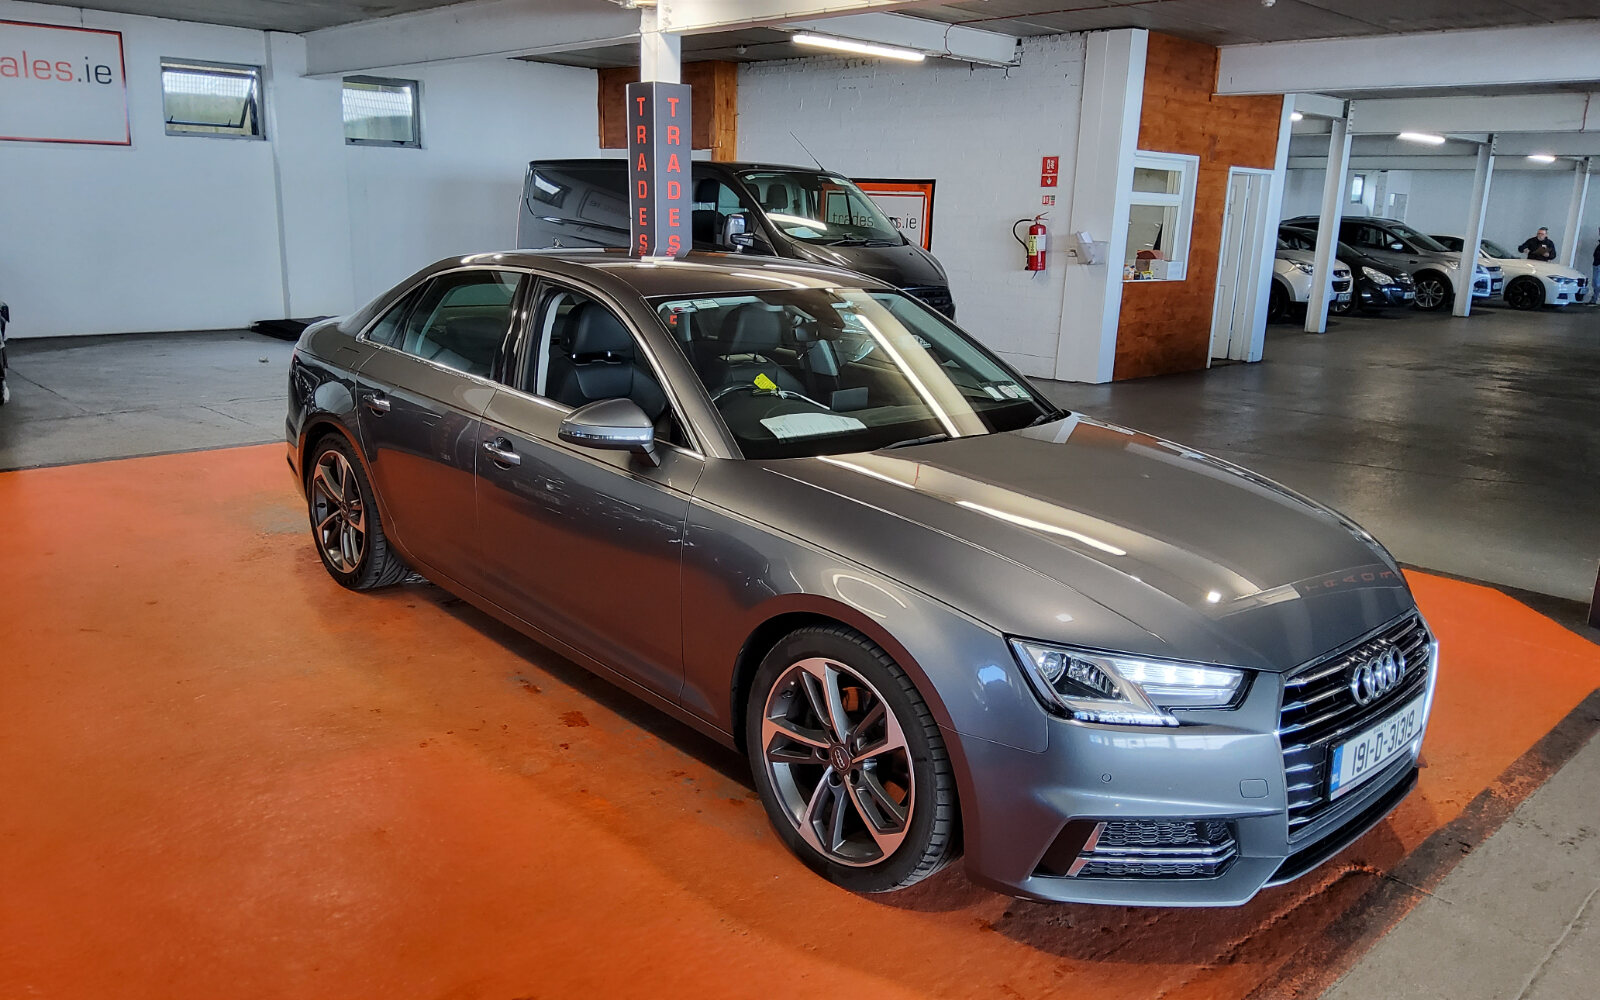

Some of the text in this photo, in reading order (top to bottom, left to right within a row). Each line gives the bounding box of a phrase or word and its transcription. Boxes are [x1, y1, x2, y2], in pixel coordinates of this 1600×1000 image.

[636, 97, 648, 251] TRADES
[667, 97, 681, 252] TRADES
[1352, 708, 1415, 776] 191-D-31319
